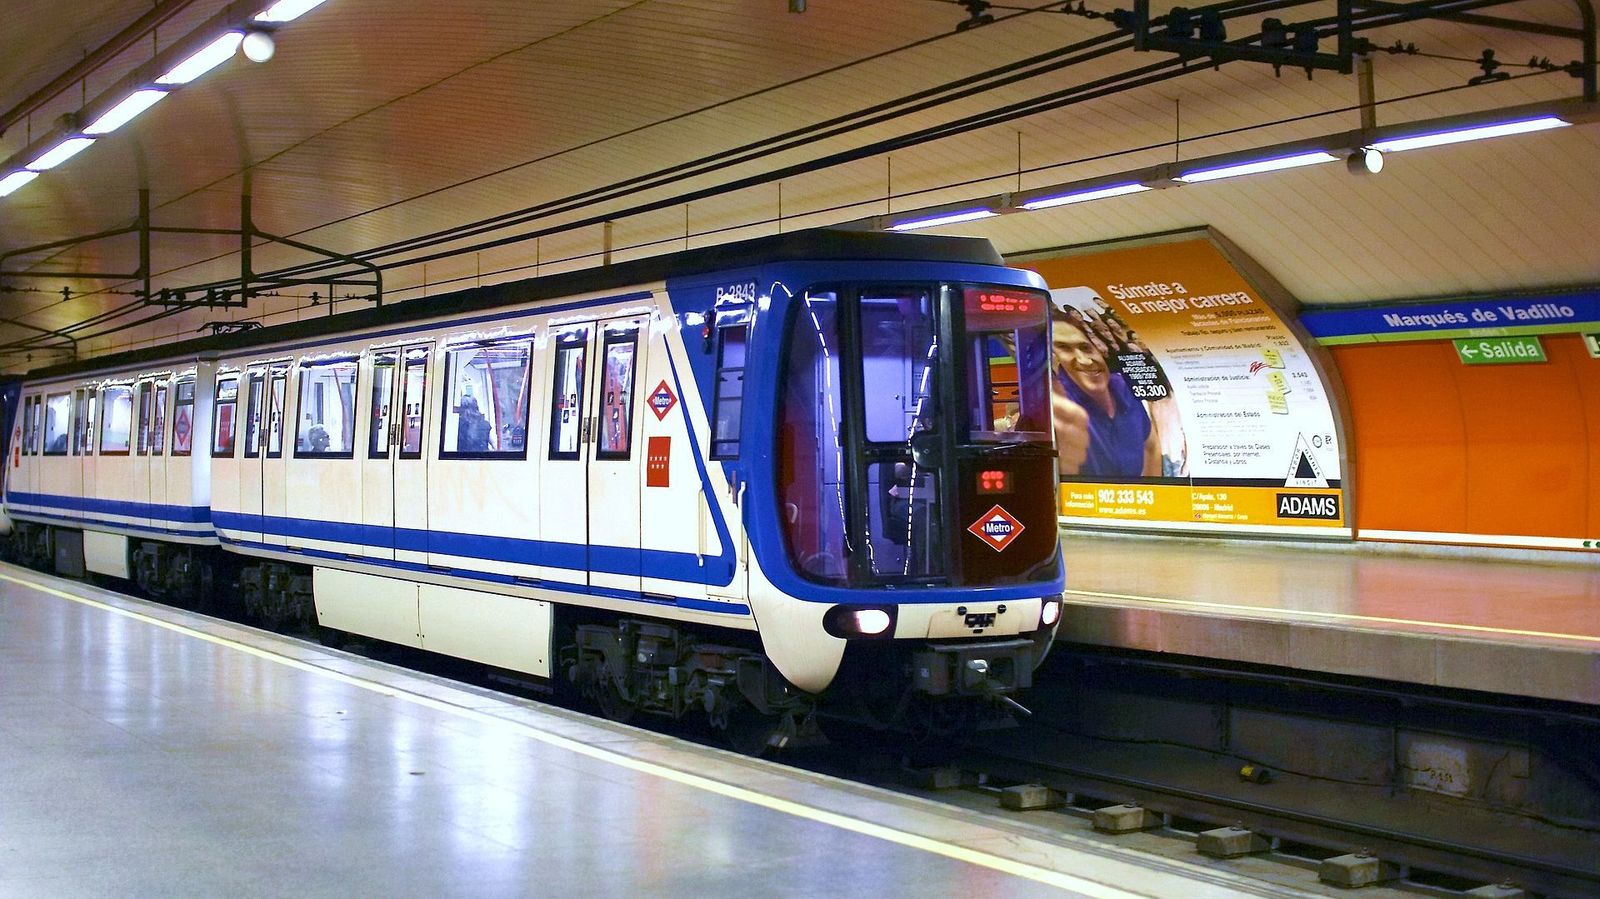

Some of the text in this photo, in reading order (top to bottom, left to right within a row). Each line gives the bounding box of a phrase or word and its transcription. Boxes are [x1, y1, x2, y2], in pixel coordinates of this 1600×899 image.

[1107, 281, 1187, 300] Súmate a
[1121, 290, 1253, 314] la mejor carrera
[1382, 303, 1575, 328] Marqués de Vadillo
[1478, 341, 1539, 359] Salida
[1132, 385, 1167, 397] 35.300
[654, 396, 671, 406] Metro
[1070, 491, 1084, 500] Para
[1098, 489, 1154, 505] 902 333 543
[1098, 507, 1146, 516] www.adams.es
[1213, 503, 1233, 511] Madrid
[1280, 496, 1336, 516] ADAMS
[985, 522, 1011, 534] Metro
